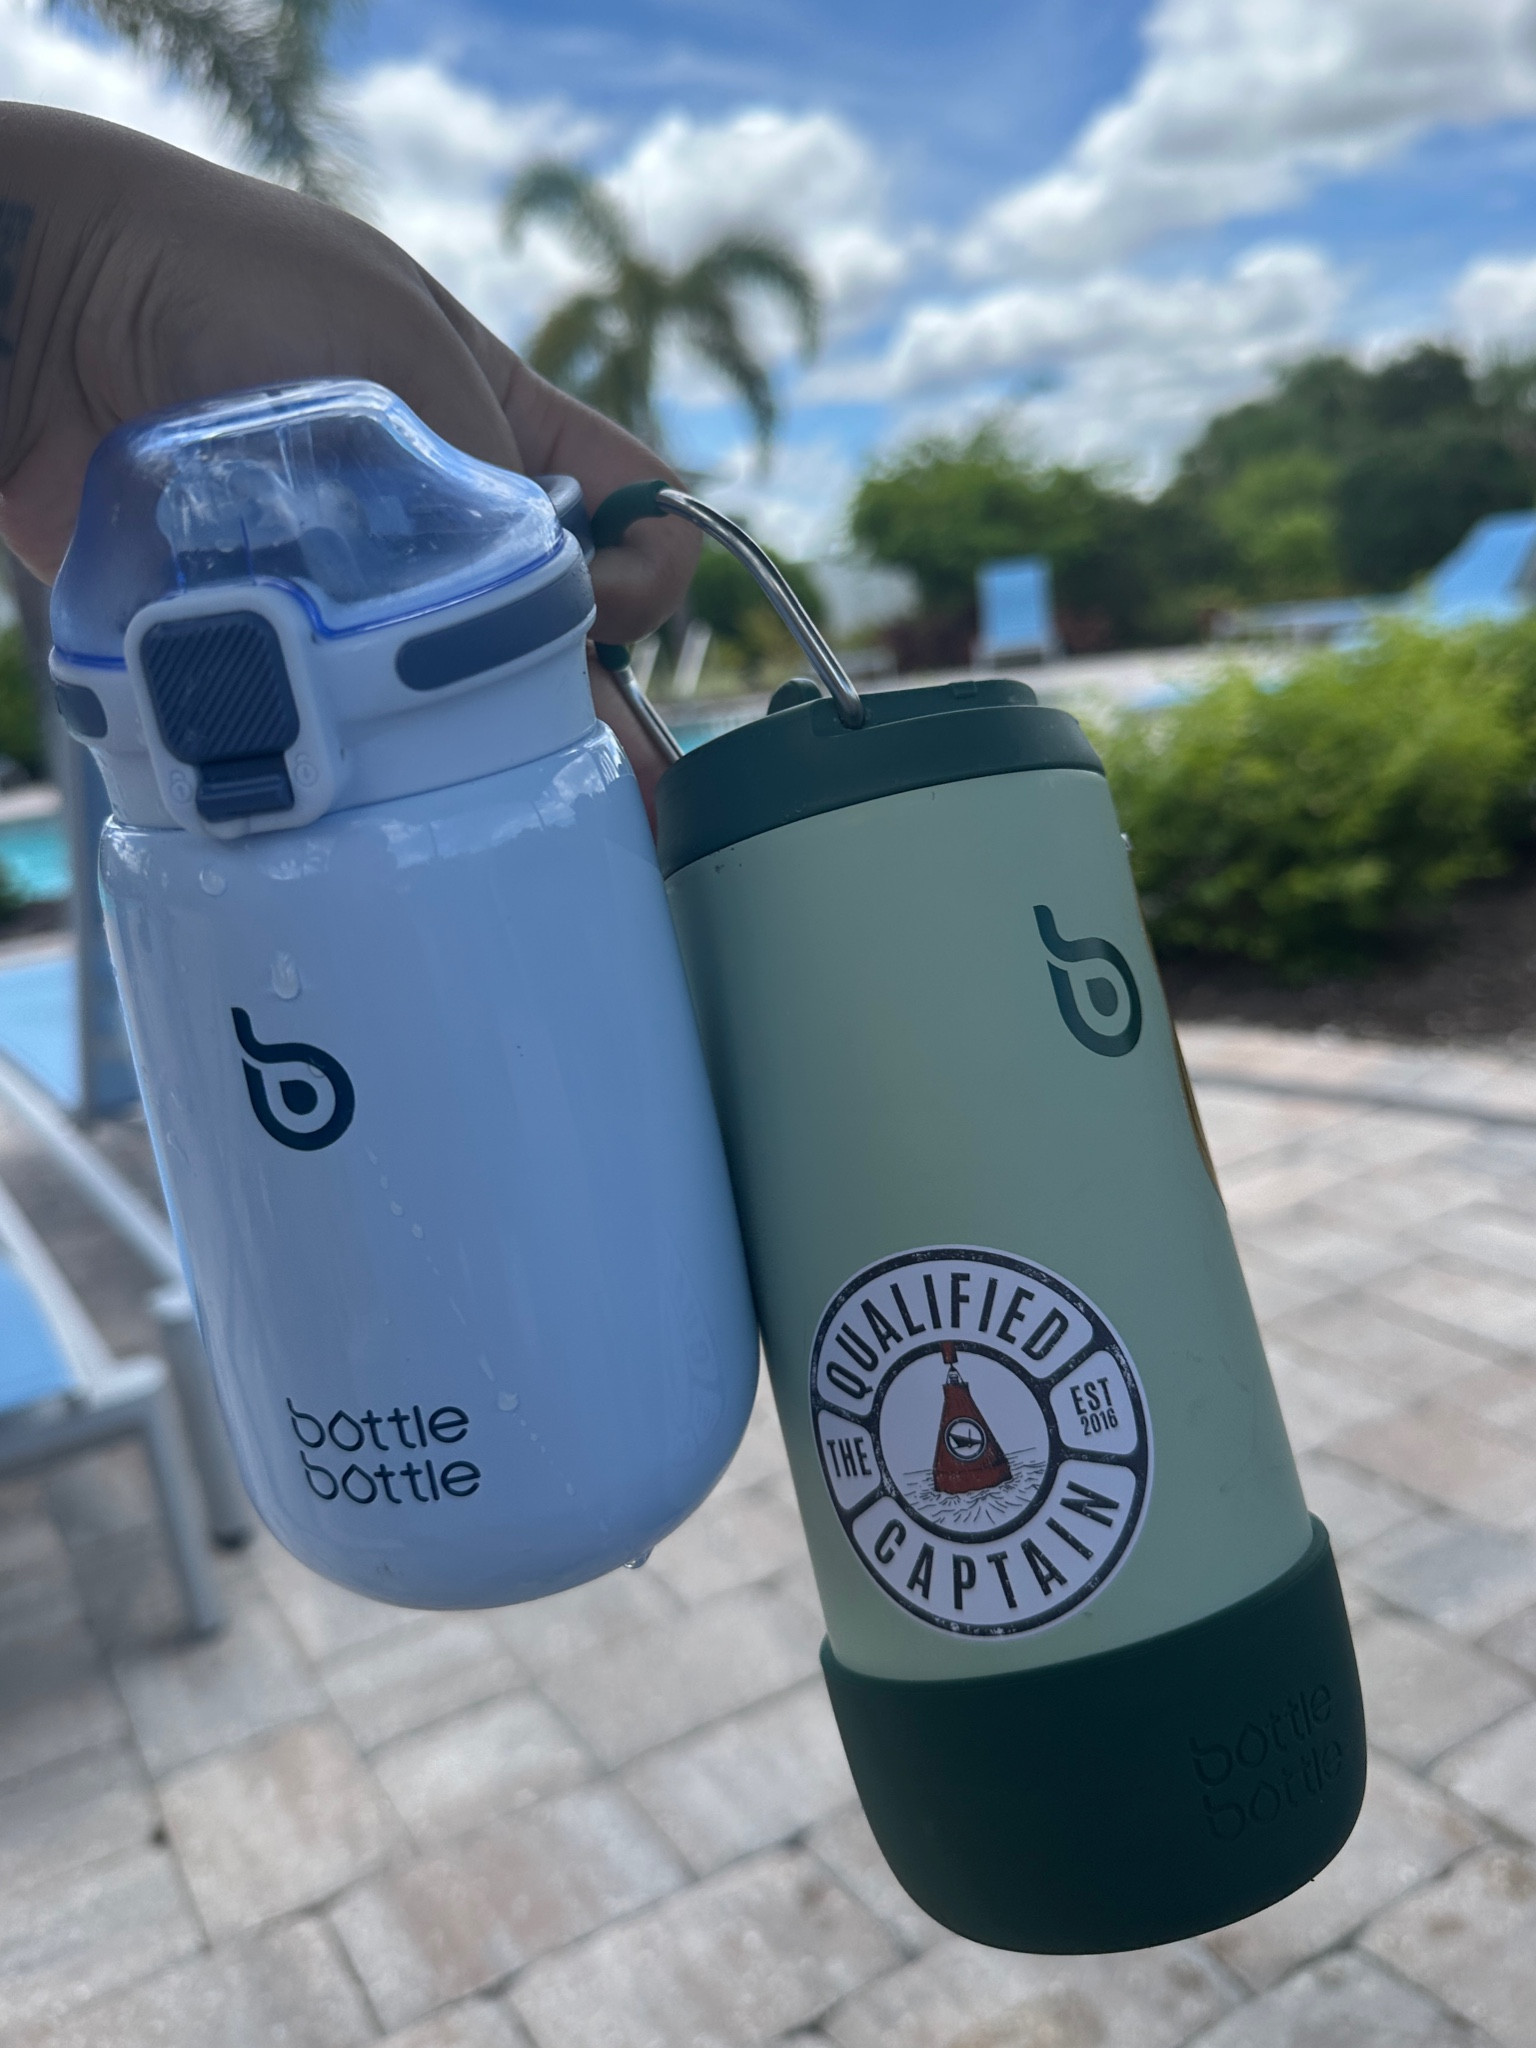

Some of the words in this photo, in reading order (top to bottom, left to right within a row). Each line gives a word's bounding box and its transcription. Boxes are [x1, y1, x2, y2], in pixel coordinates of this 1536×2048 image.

[826, 1272, 1069, 1399] QUALIFIED
[1070, 1376, 1115, 1415] EST
[1080, 1408, 1119, 1437] 2016
[286, 1397, 470, 1451] bottle
[300, 1449, 482, 1505] bottle
[826, 1436, 872, 1478] THE
[874, 1480, 1120, 1610] CAPTAIN
